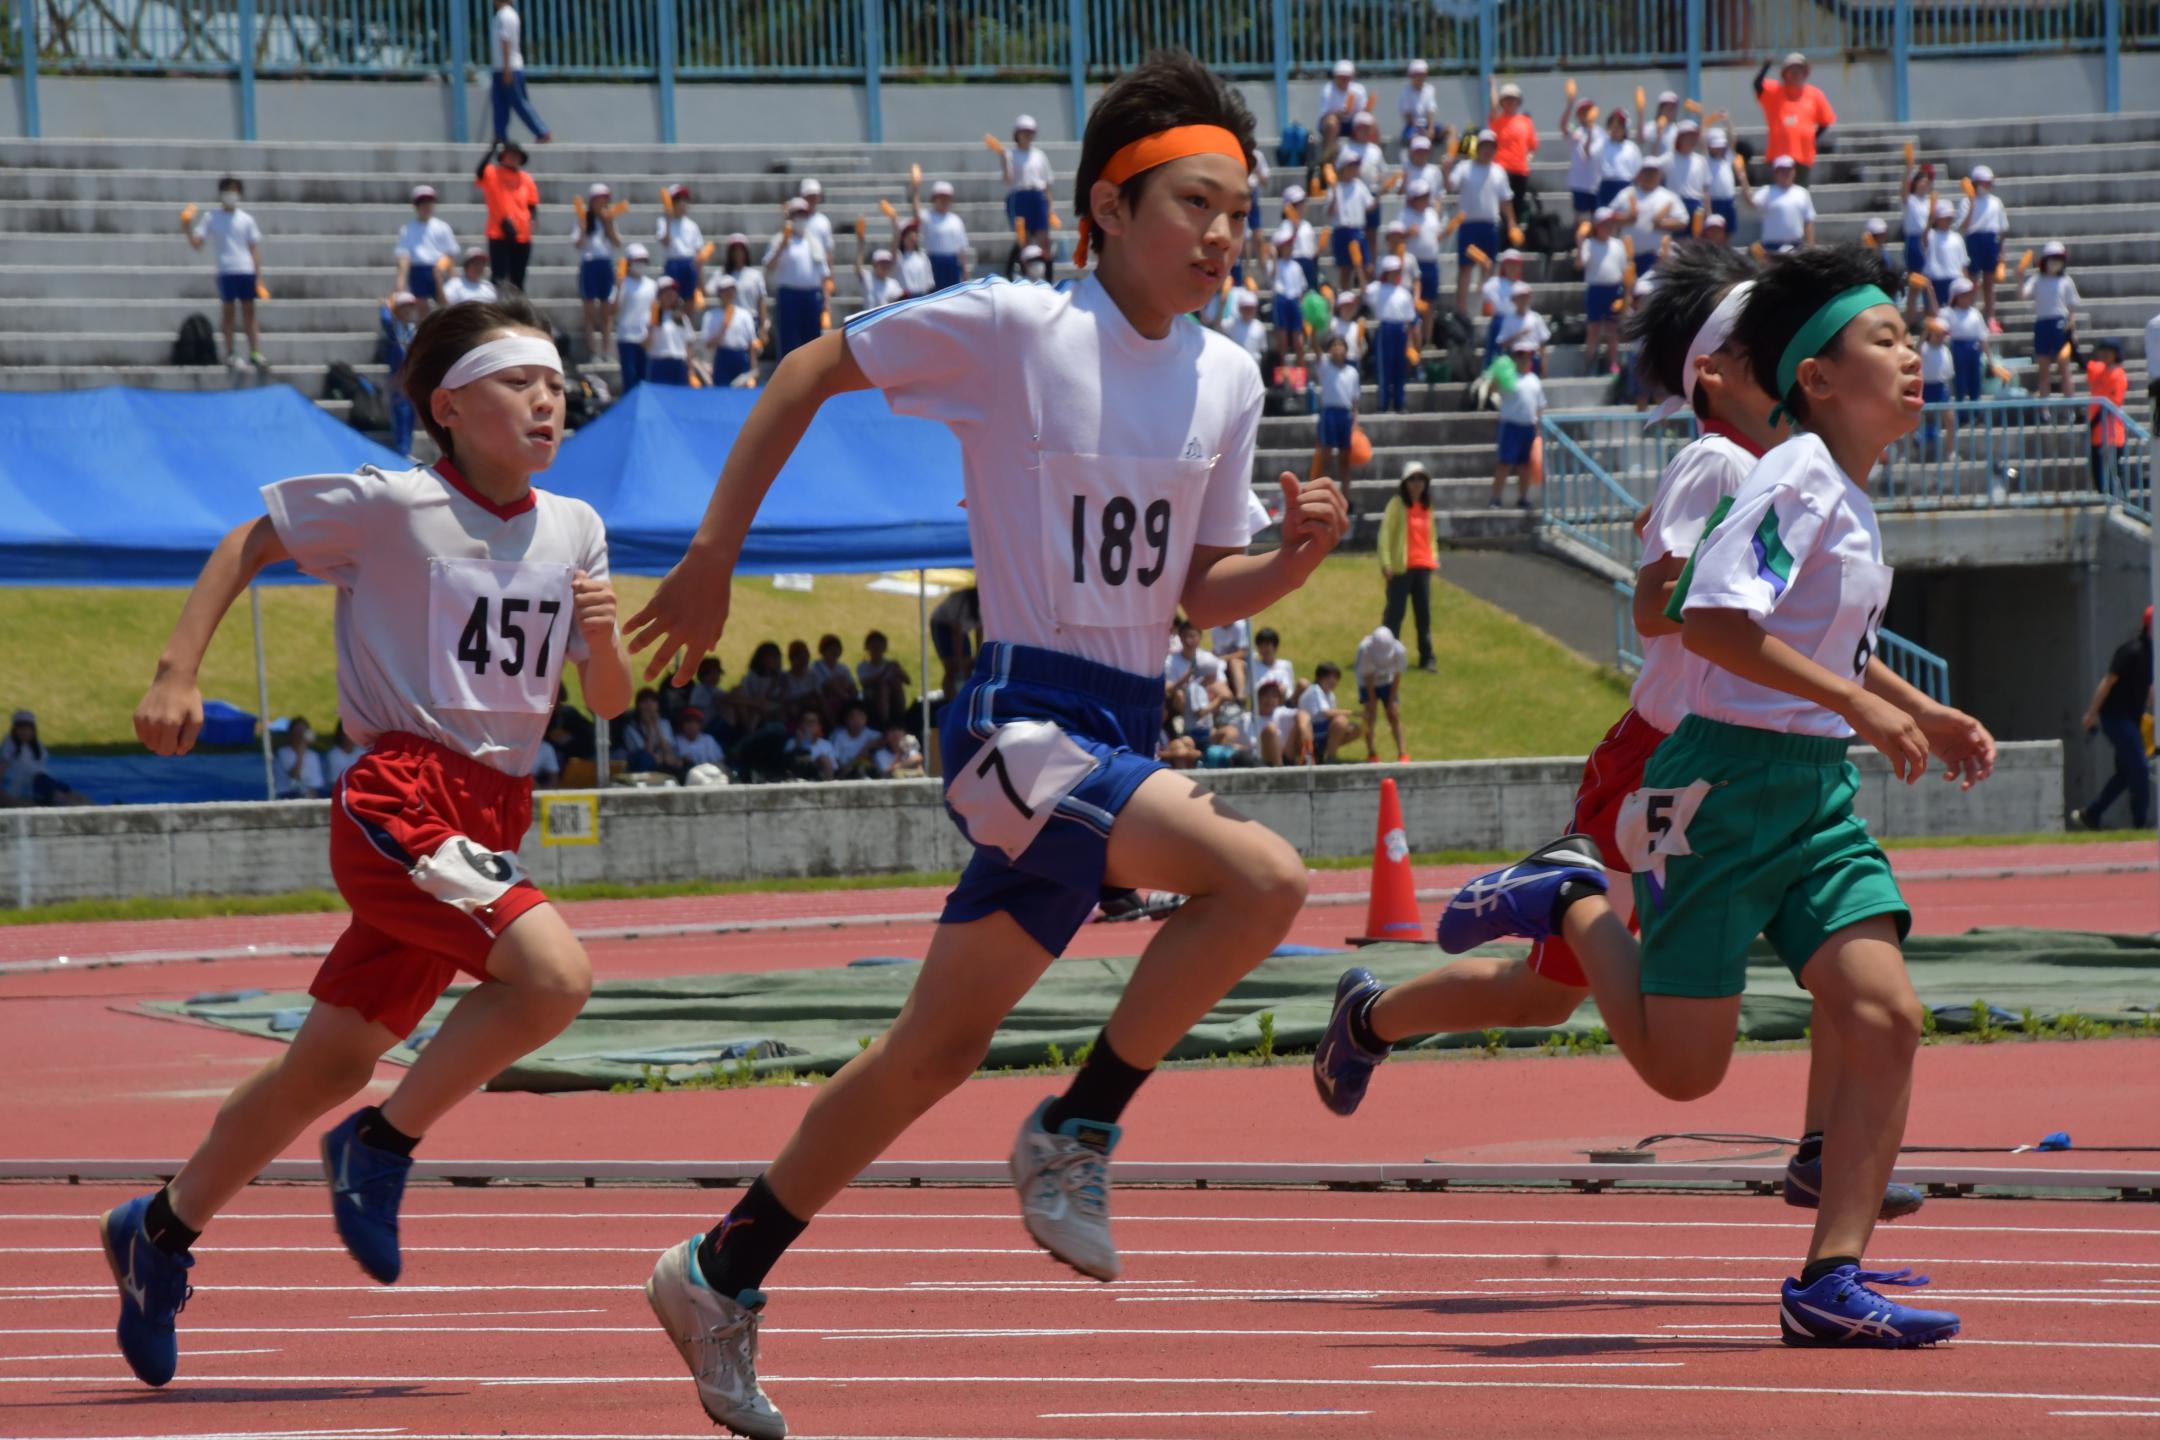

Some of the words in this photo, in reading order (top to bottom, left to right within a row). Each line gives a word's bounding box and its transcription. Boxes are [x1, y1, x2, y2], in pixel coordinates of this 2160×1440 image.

[1072, 494, 1172, 588] 189
[458, 596, 561, 678] 457
[1853, 604, 1885, 676] 6
[976, 746, 1035, 820] 7
[457, 840, 512, 882] 6
[1646, 795, 1674, 856] 5
